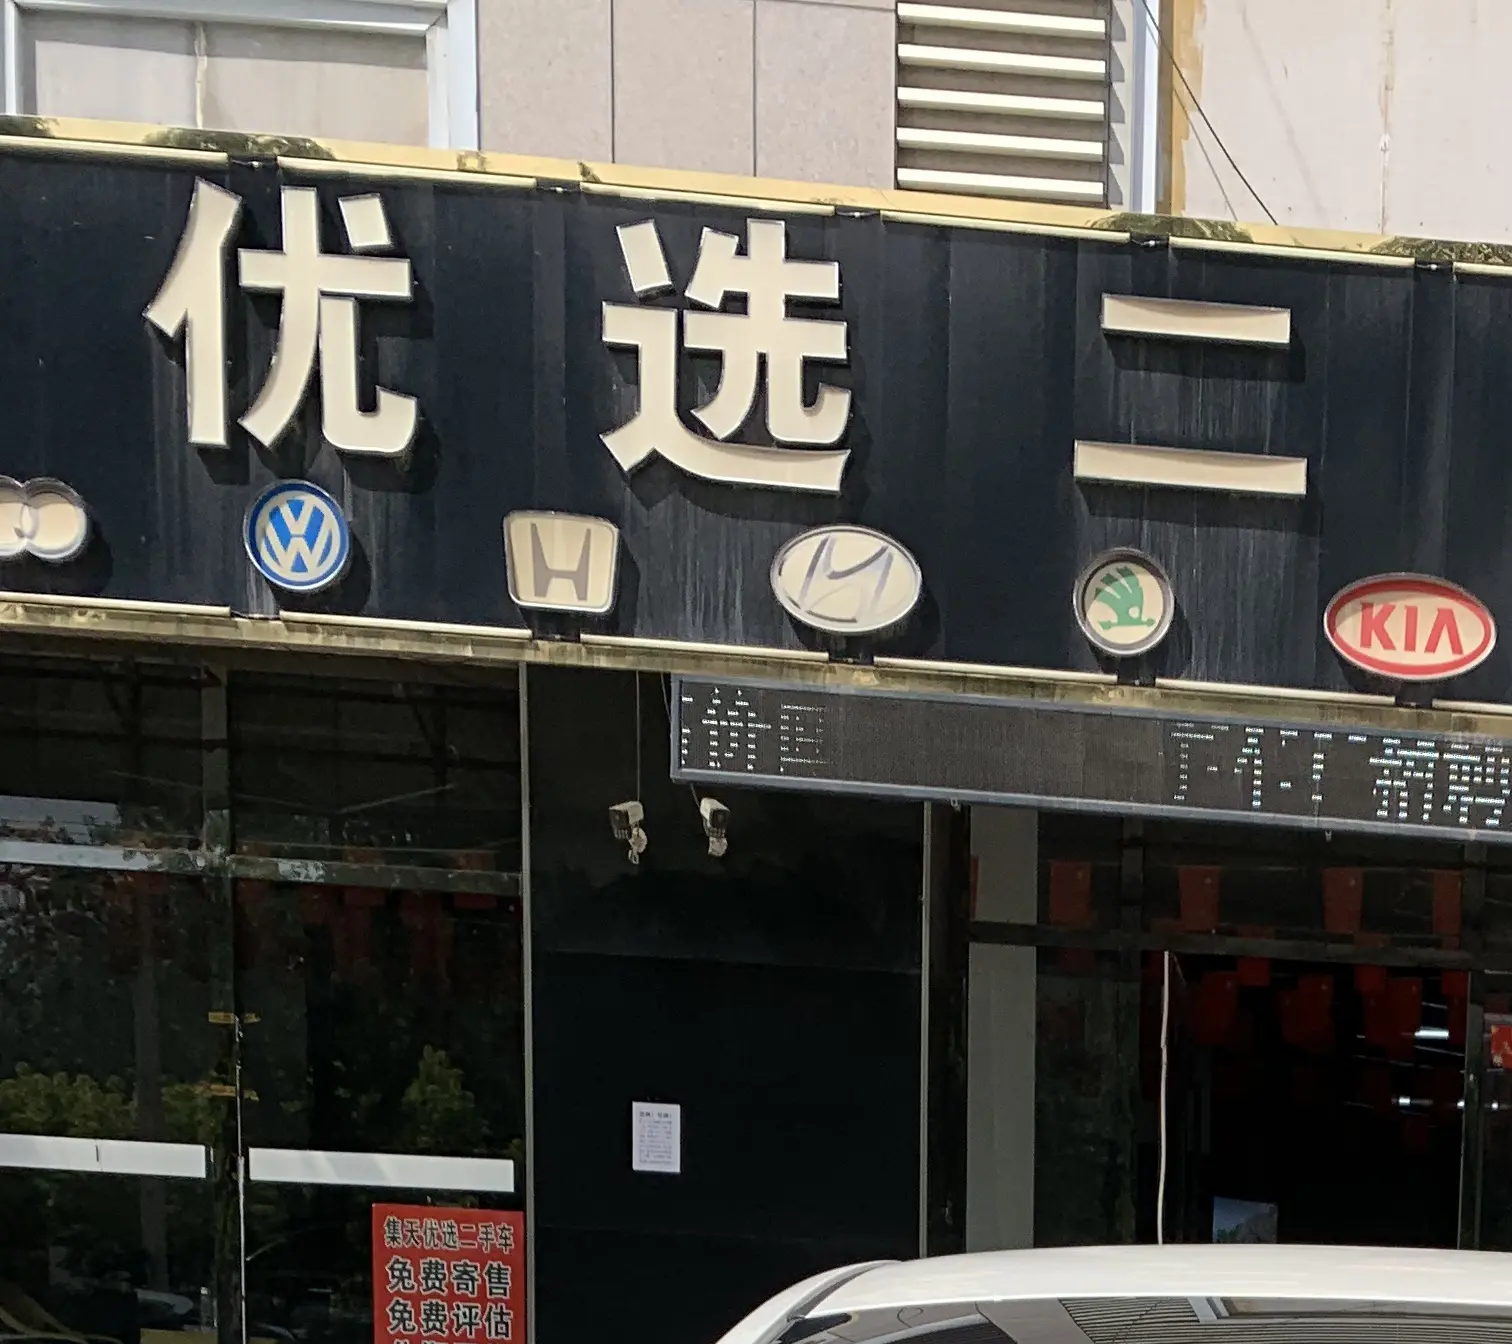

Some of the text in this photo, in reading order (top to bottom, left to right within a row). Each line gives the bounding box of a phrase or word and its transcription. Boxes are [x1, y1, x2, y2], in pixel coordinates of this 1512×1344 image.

[1358, 602, 1464, 657] KIA
[384, 1216, 515, 1255] 集天优选二手车
[386, 1255, 512, 1299] 免费寄售
[386, 1297, 514, 1340] 免费评估
